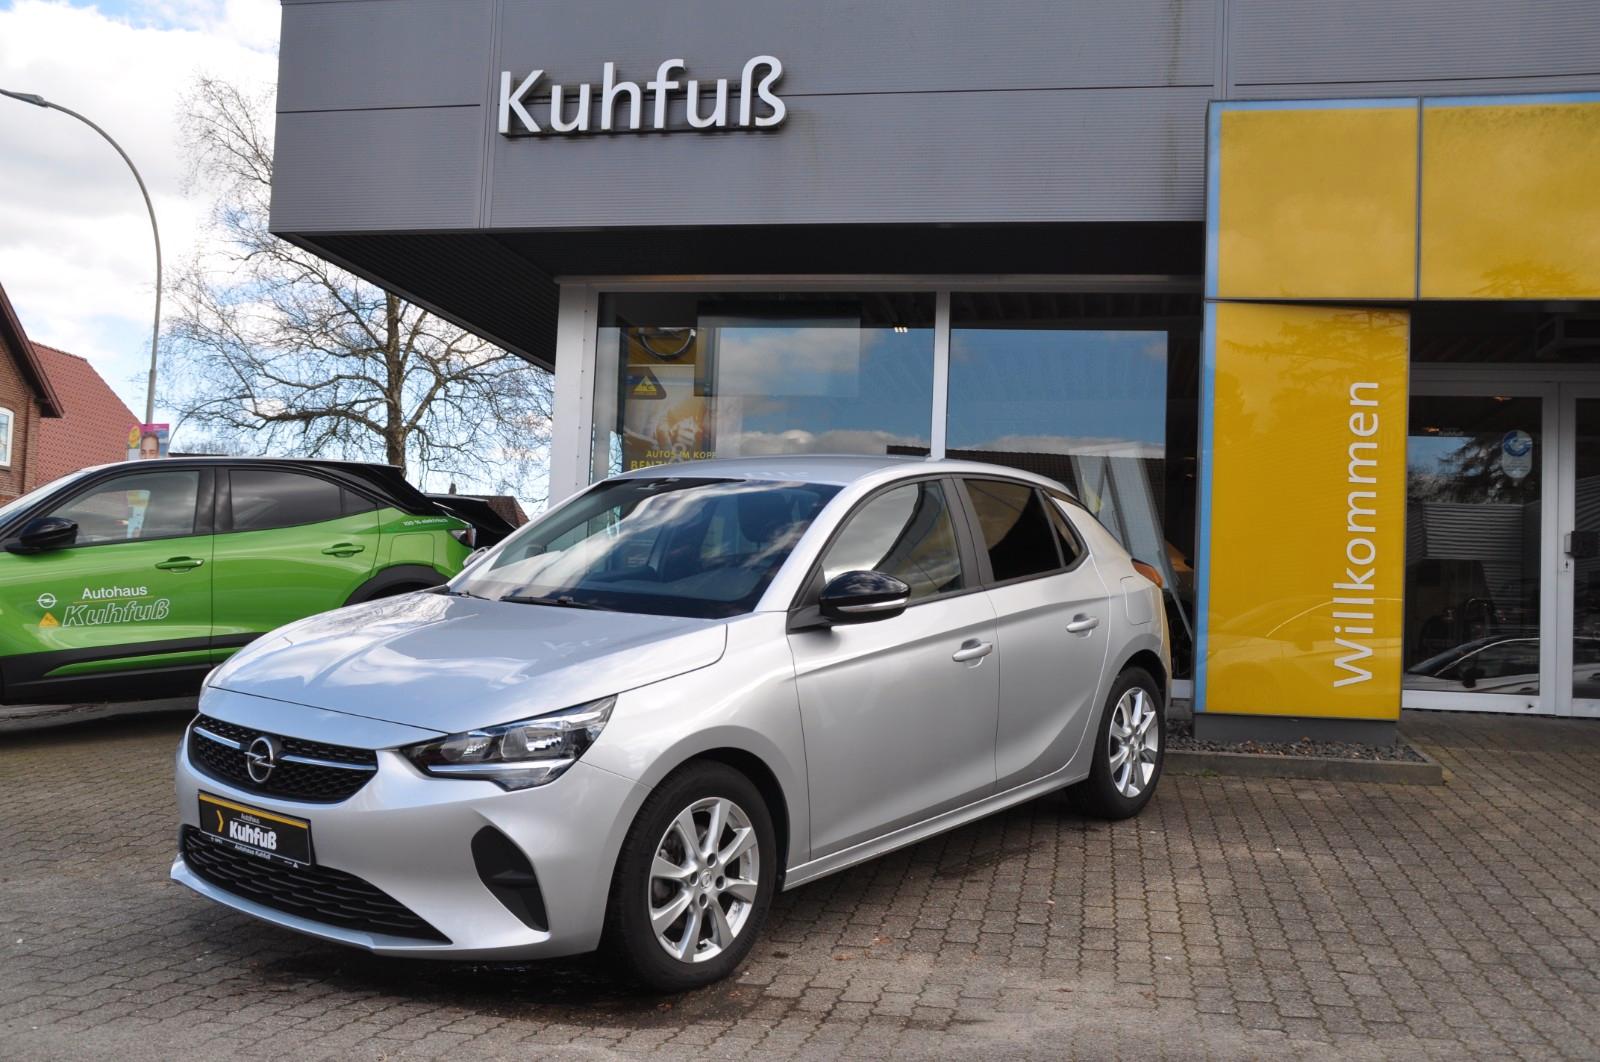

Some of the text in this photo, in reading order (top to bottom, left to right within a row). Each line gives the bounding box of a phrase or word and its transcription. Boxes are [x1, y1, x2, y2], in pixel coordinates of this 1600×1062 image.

[499, 55, 787, 135] Kuhfuß
[645, 450, 676, 459] AUTOS
[1332, 381, 1379, 688] Willkommen
[82, 586, 148, 600] Autohaus
[62, 598, 170, 627] Kuhfuß
[229, 820, 277, 851] Kuhfuß
